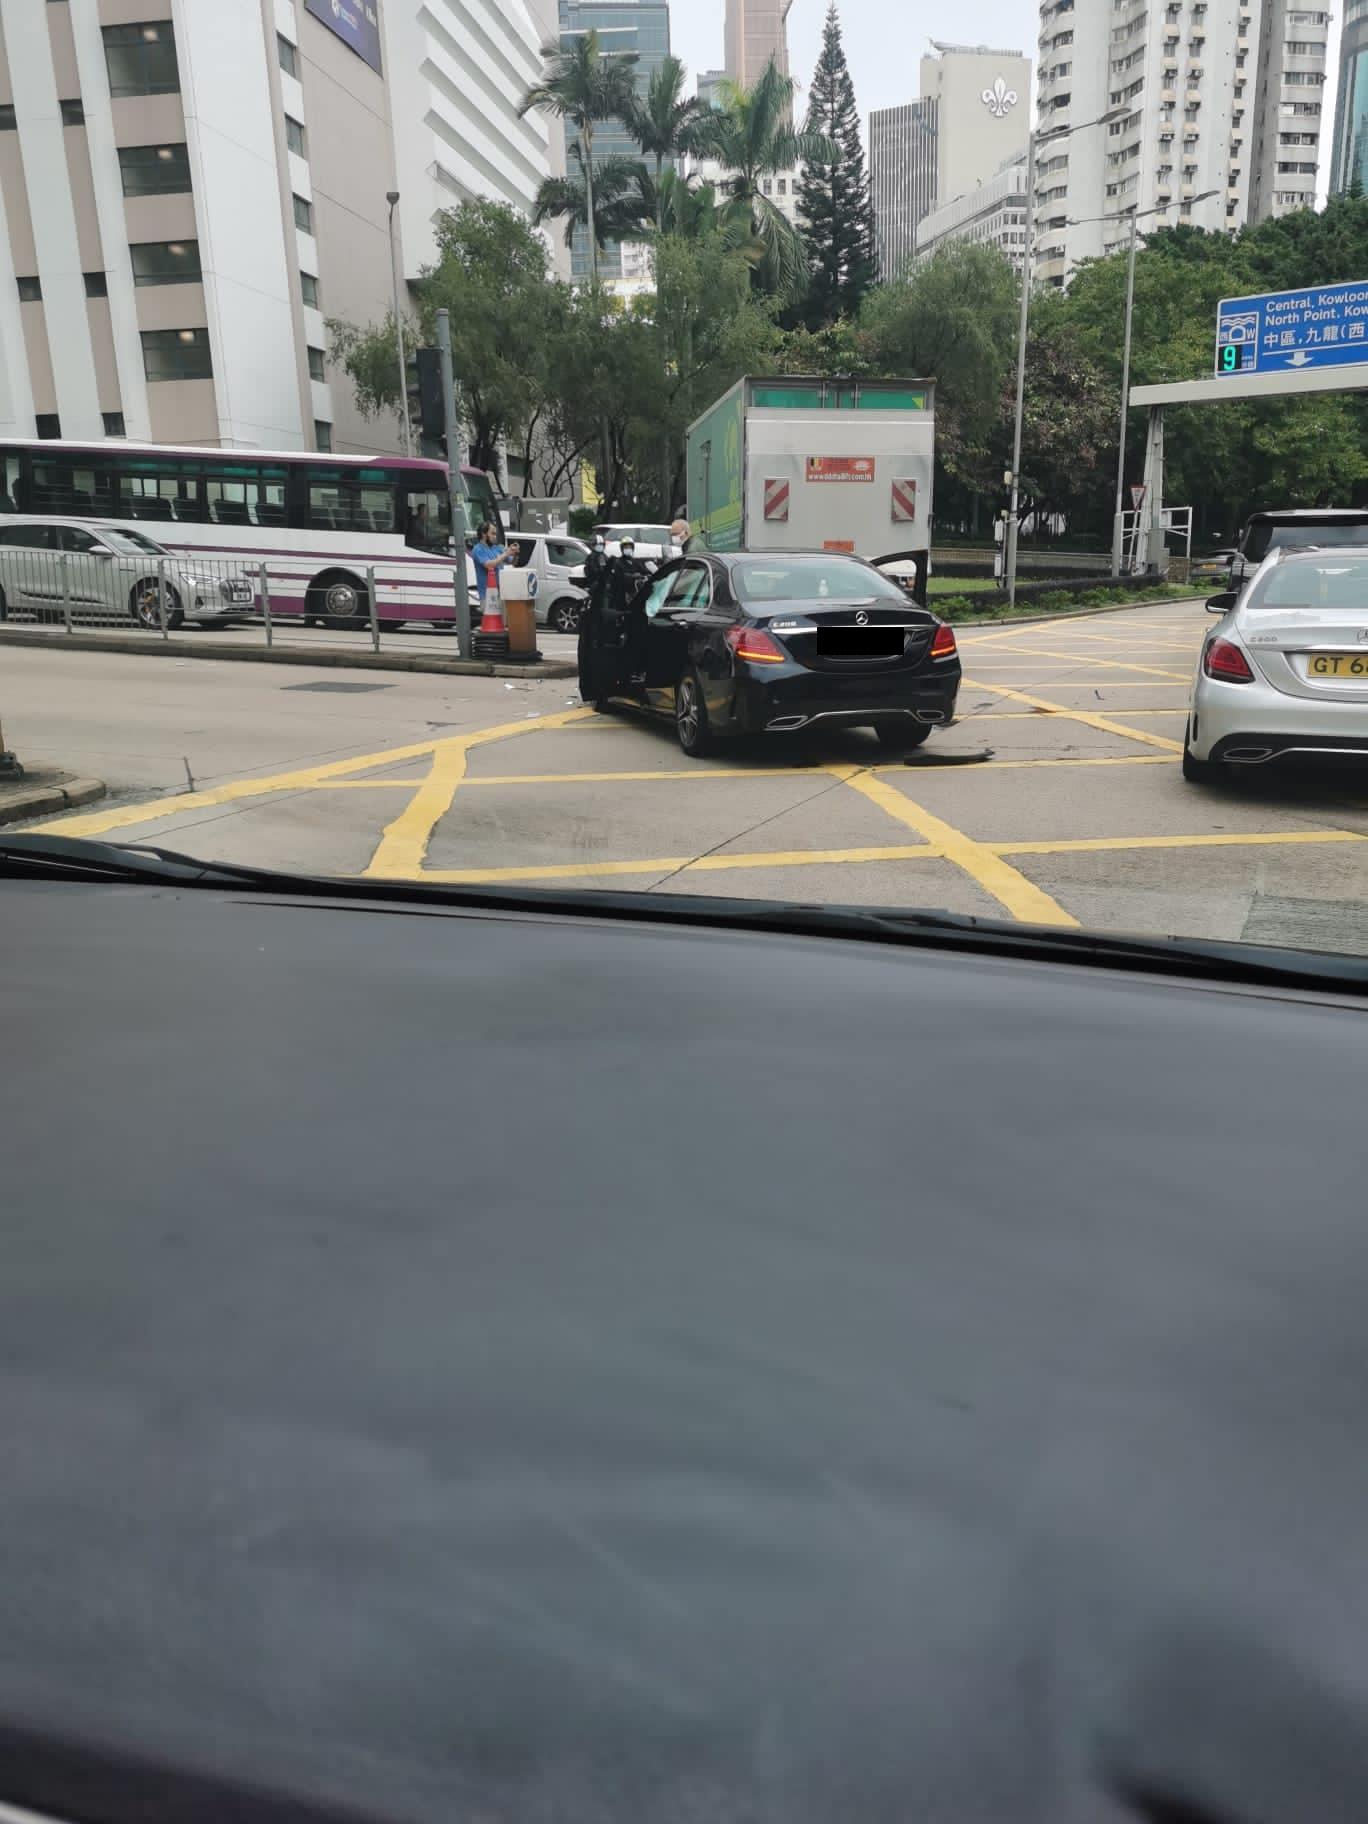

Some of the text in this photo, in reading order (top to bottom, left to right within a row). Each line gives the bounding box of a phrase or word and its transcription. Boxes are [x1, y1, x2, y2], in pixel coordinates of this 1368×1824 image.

[1266, 296, 1315, 312] Central,
[1265, 312, 1300, 327] North
[1246, 327, 1256, 340] W
[1223, 344, 1236, 371] 9
[1314, 657, 1368, 675] GT 6
